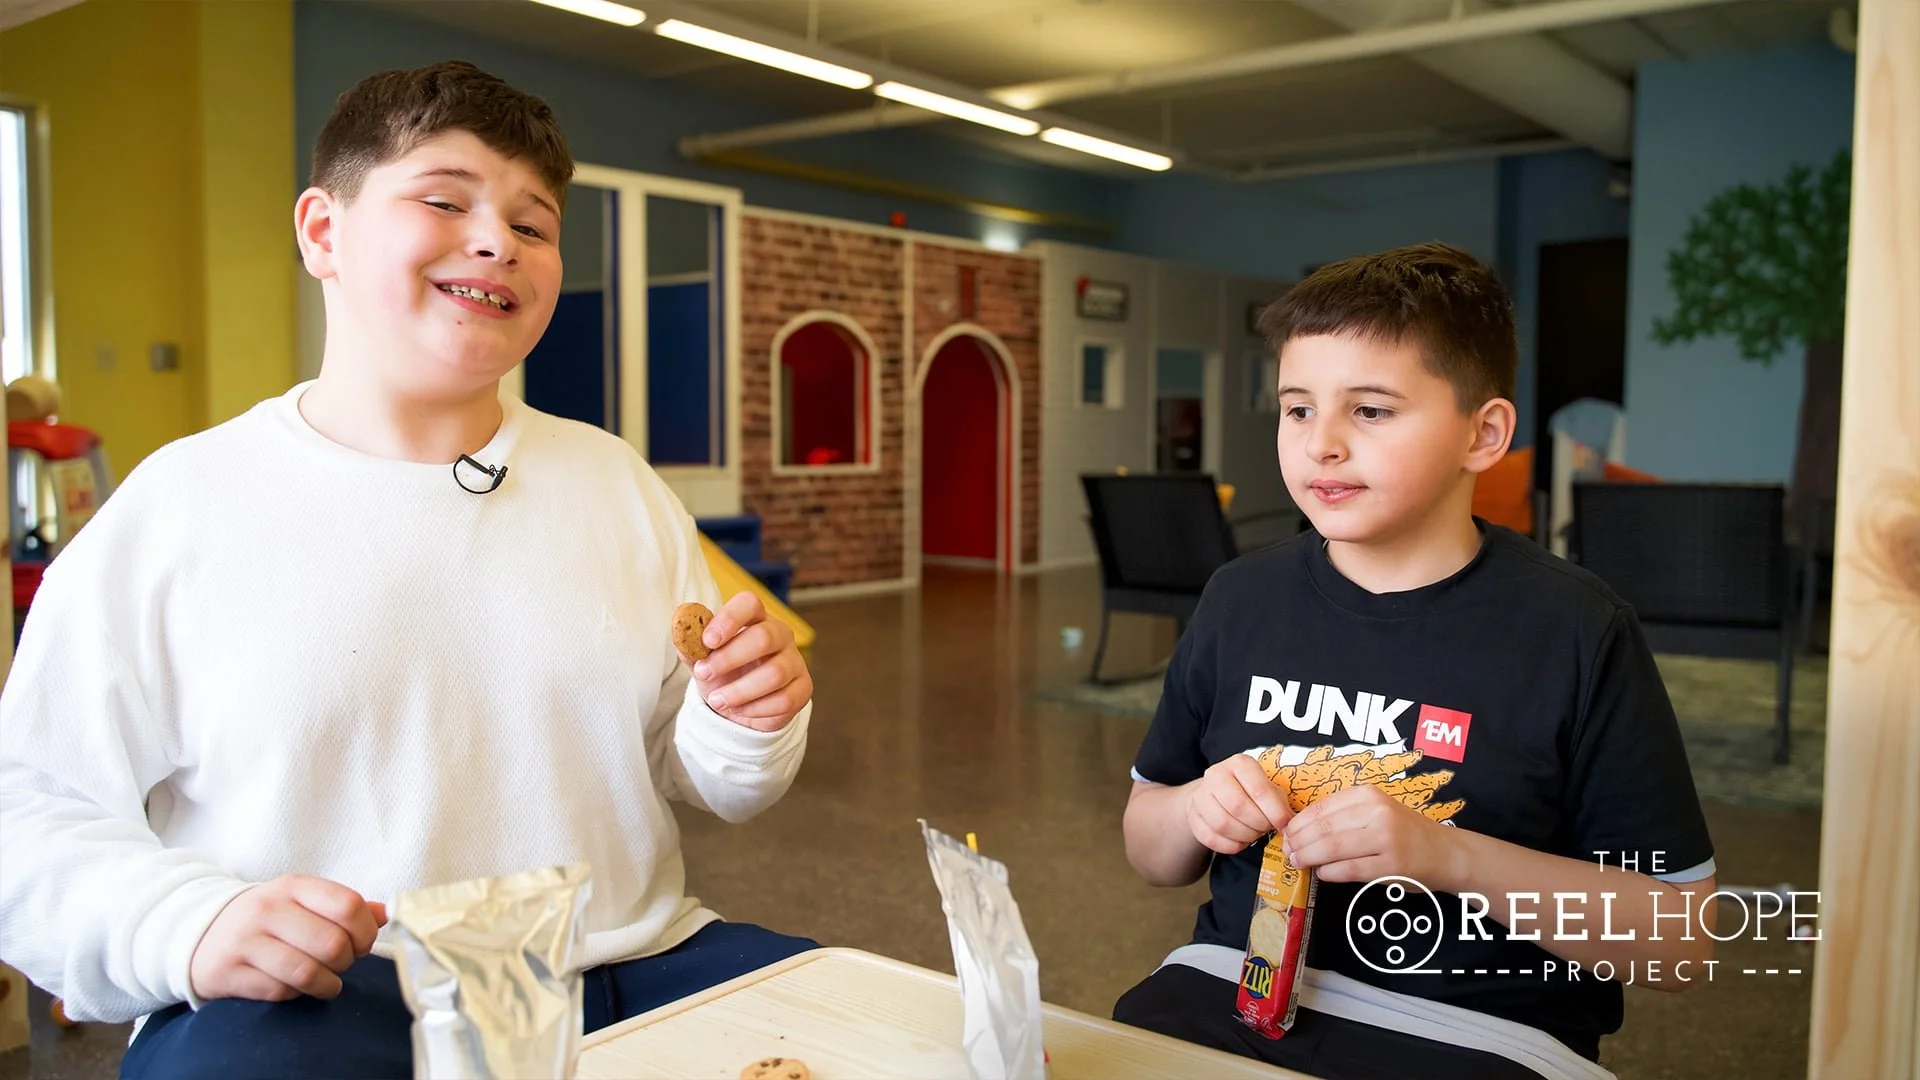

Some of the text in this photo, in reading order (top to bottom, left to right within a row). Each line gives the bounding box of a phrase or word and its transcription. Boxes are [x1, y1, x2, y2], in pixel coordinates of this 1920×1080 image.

[1244, 675, 1462, 747] DUNK 'EM
[1241, 960, 1274, 1000] RITZ
